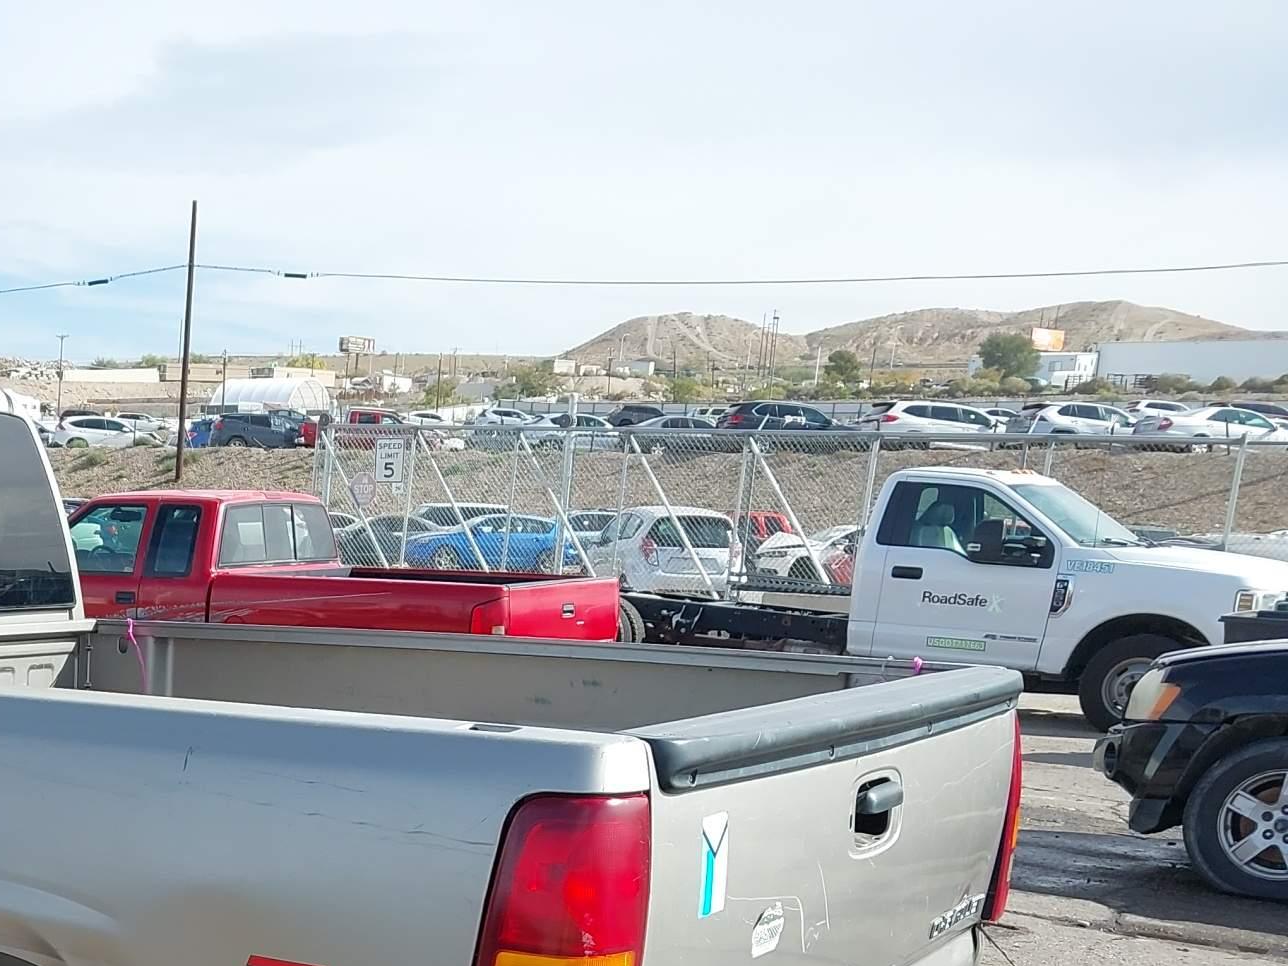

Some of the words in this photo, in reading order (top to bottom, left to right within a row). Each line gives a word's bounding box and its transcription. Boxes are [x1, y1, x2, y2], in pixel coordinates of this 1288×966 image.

[378, 442, 403, 450] SPEED
[380, 452, 400, 460] LIMIT
[383, 462, 395, 478] 5
[353, 484, 374, 494] STOP
[921, 590, 988, 608] RoadSafe
